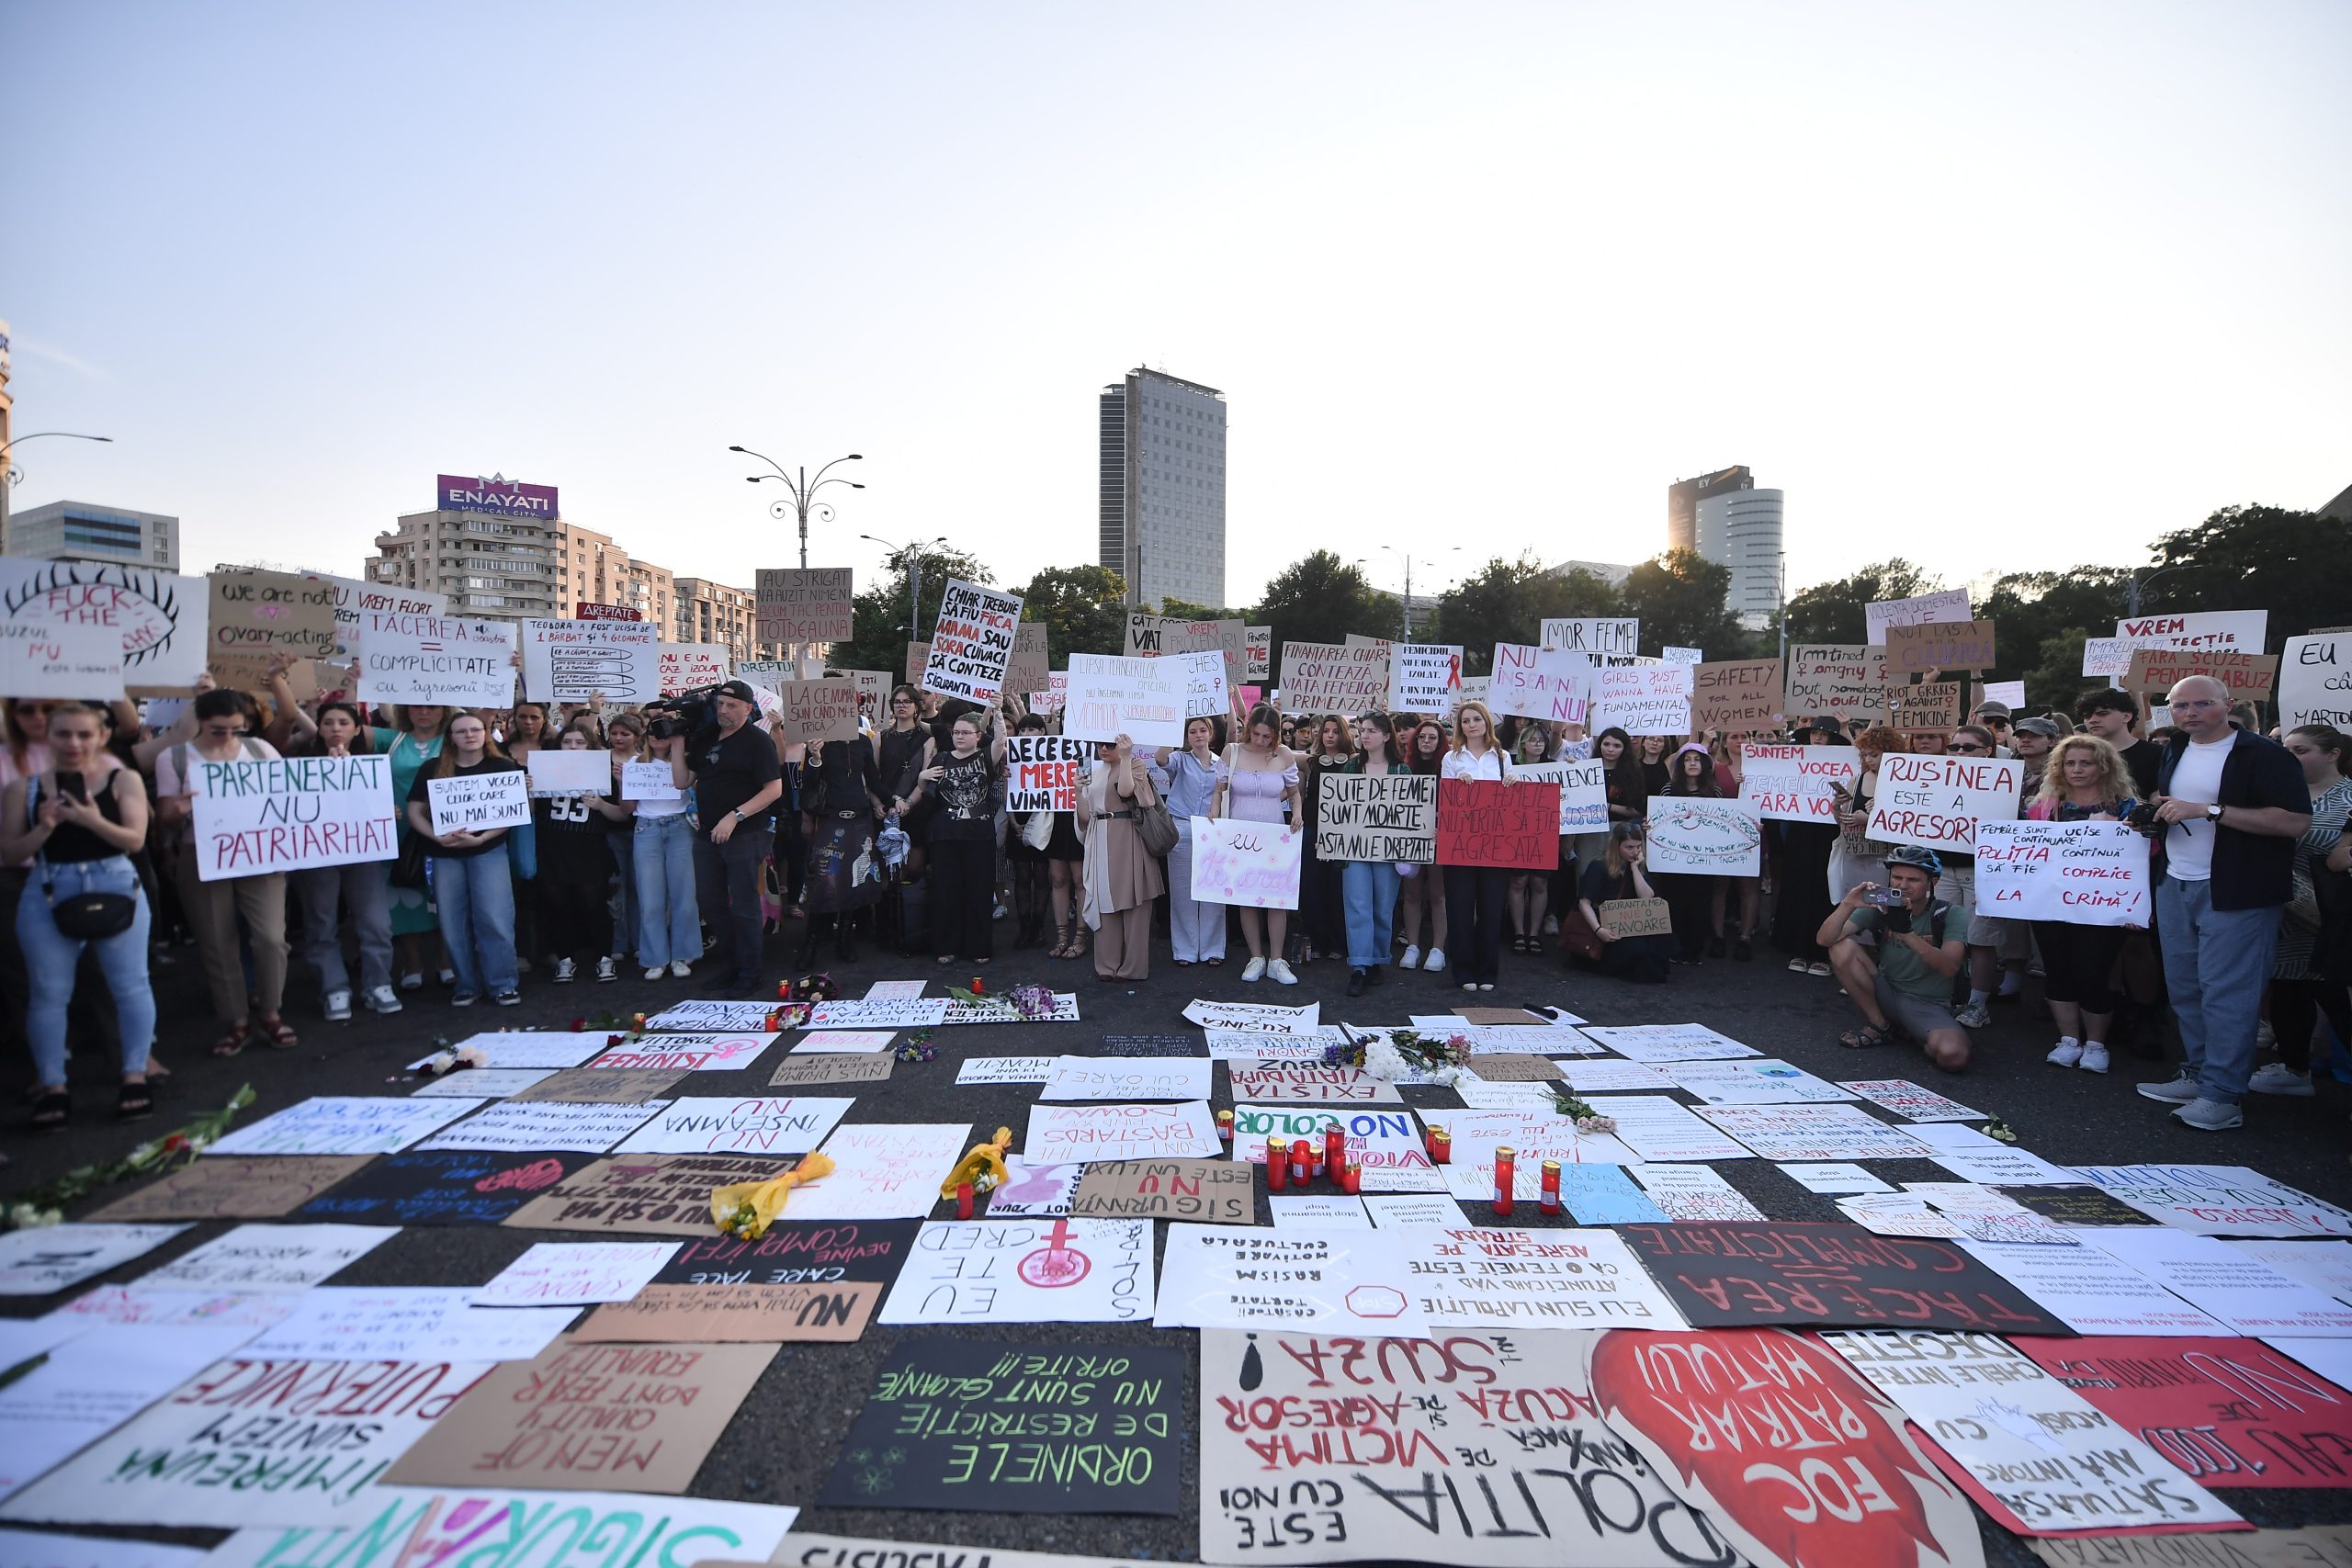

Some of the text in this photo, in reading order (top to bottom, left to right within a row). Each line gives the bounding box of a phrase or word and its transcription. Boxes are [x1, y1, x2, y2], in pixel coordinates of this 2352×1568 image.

[1699, 478, 1710, 489] EY
[450, 489, 548, 511] ENAYATI
[764, 570, 849, 587] AU STRIGAT
[48, 583, 130, 611] FUCK
[261, 581, 334, 605] are not
[54, 608, 119, 626] THE
[760, 603, 849, 617] ACUM TAC PENTRU
[943, 602, 959, 618] SĂ
[530, 621, 571, 629] TEODORA
[756, 619, 849, 639] TOTDEAUNA
[1186, 623, 1218, 635] VREM
[2124, 617, 2185, 637] VREM
[537, 632, 606, 642] 1 4
[936, 618, 1011, 651] MAMA SAU
[1547, 622, 1586, 650] MOR
[933, 636, 964, 655] SORA
[1353, 646, 1385, 661] CHIAR
[1404, 647, 1451, 655] FEMICIDUL
[1830, 648, 1866, 661] tired
[2300, 643, 2336, 665] EU
[661, 654, 678, 662] NU
[696, 654, 709, 662] UN
[1080, 659, 1103, 674] LIPSA
[1501, 646, 1537, 669] NU
[2190, 653, 2252, 667] SCUZE
[660, 665, 682, 673] CAZ
[928, 653, 946, 669] SĂ
[948, 658, 1003, 682] CONTEZE
[1298, 662, 1373, 681] CONTEAZĂ
[1409, 671, 1441, 679] IZOLAT.
[1814, 665, 1866, 681] angry
[662, 677, 678, 685] SE
[1602, 670, 1680, 685] GIRLS JUST
[1699, 665, 1777, 689] SAFETY
[2222, 671, 2272, 689] ABUZ
[790, 686, 809, 705] LA
[1323, 679, 1382, 695] FEMEILOR
[1602, 684, 1683, 700] WANNA HAVE
[1792, 681, 1820, 696] but
[1887, 684, 1957, 699] RIOT GRRRLS
[1406, 698, 1444, 706] IGNORAT.
[1709, 691, 1765, 704] FOR ALL
[1804, 694, 1860, 708] should
[1904, 698, 1943, 707] AGAINST
[1603, 699, 1686, 715] FUNDAMENTAL
[1623, 712, 1688, 730] RIGHTS!
[1892, 711, 1952, 728] FEMICIDE
[1746, 745, 1804, 760] SUNTEM
[202, 758, 384, 798] PARTENERIAT
[1798, 762, 1853, 777] VOCEA
[1885, 756, 2013, 793] RUȘINEA
[435, 776, 521, 795] SUNTEM VOCEA
[1321, 775, 1435, 805] SUTE DE FEMEI
[447, 790, 506, 806] CELOR CARE
[1010, 792, 1051, 810] VINA
[1894, 791, 1964, 811] ESTE A
[259, 795, 321, 825] NU
[440, 811, 459, 825] NU
[492, 803, 526, 820] SUNT
[550, 796, 590, 823] 93
[1319, 802, 1360, 825] SUNT
[1980, 825, 2101, 838] FEMEILE SUNT UCISE
[213, 818, 392, 870] PATRIARHAT
[1228, 833, 1262, 852] eu
[1345, 834, 1433, 863] NU DREPTATE
[1661, 850, 1677, 861] CU
[1977, 844, 2050, 865] POLIȚIA
[1985, 862, 2132, 880] SĂ FIE COMPLICE
[1996, 889, 2022, 902] LA
[1608, 919, 1668, 935] FAVOARE
[588, 1053, 719, 1069] FEMINIST
[732, 1099, 794, 1115] NU
[1044, 1122, 1194, 1144] BASTARDS
[1234, 1111, 1410, 1137] NO COLOR
[708, 1130, 779, 1149] NU
[1146, 1164, 1251, 1185] ESTE UN
[1137, 1175, 1200, 1196] NU
[989, 1204, 1033, 1214] YOUR
[1068, 1192, 1242, 1219] SIGURANȚA
[1335, 1210, 1358, 1218] Stop
[1380, 1202, 1445, 1212] complicitate!
[919, 1225, 1035, 1251] CRED
[1236, 1251, 1328, 1263] MOTIVARE
[1432, 1244, 1466, 1257] PE
[1626, 1224, 1965, 1274] COMPLICITATE
[766, 1267, 845, 1284] CARE
[930, 1257, 996, 1280] TE
[1236, 1270, 1321, 1282] RASISM
[1408, 1260, 1583, 1275] O FEMEIE ESTE
[1547, 1279, 1617, 1294] ATUNCI
[919, 1284, 998, 1314] EU
[795, 1292, 859, 1326] NU
[1607, 1301, 1653, 1318] EU
[541, 1347, 704, 1377] EQUALITY
[994, 1379, 1161, 1405] NU SUNT
[515, 1404, 657, 1430] QUALITY
[1215, 1391, 1412, 1433] AGRESOR
[187, 1413, 383, 1451] SUNTEM
[1114, 1413, 1169, 1438] DE
[1935, 1417, 1988, 1441] CU
[549, 1435, 662, 1473] MEN
[941, 1442, 1153, 1491] ORDINELE
[1219, 1480, 1344, 1517] CU NOI
[1742, 1455, 1900, 1524] FOC
[1234, 1512, 1348, 1549] ESTE
